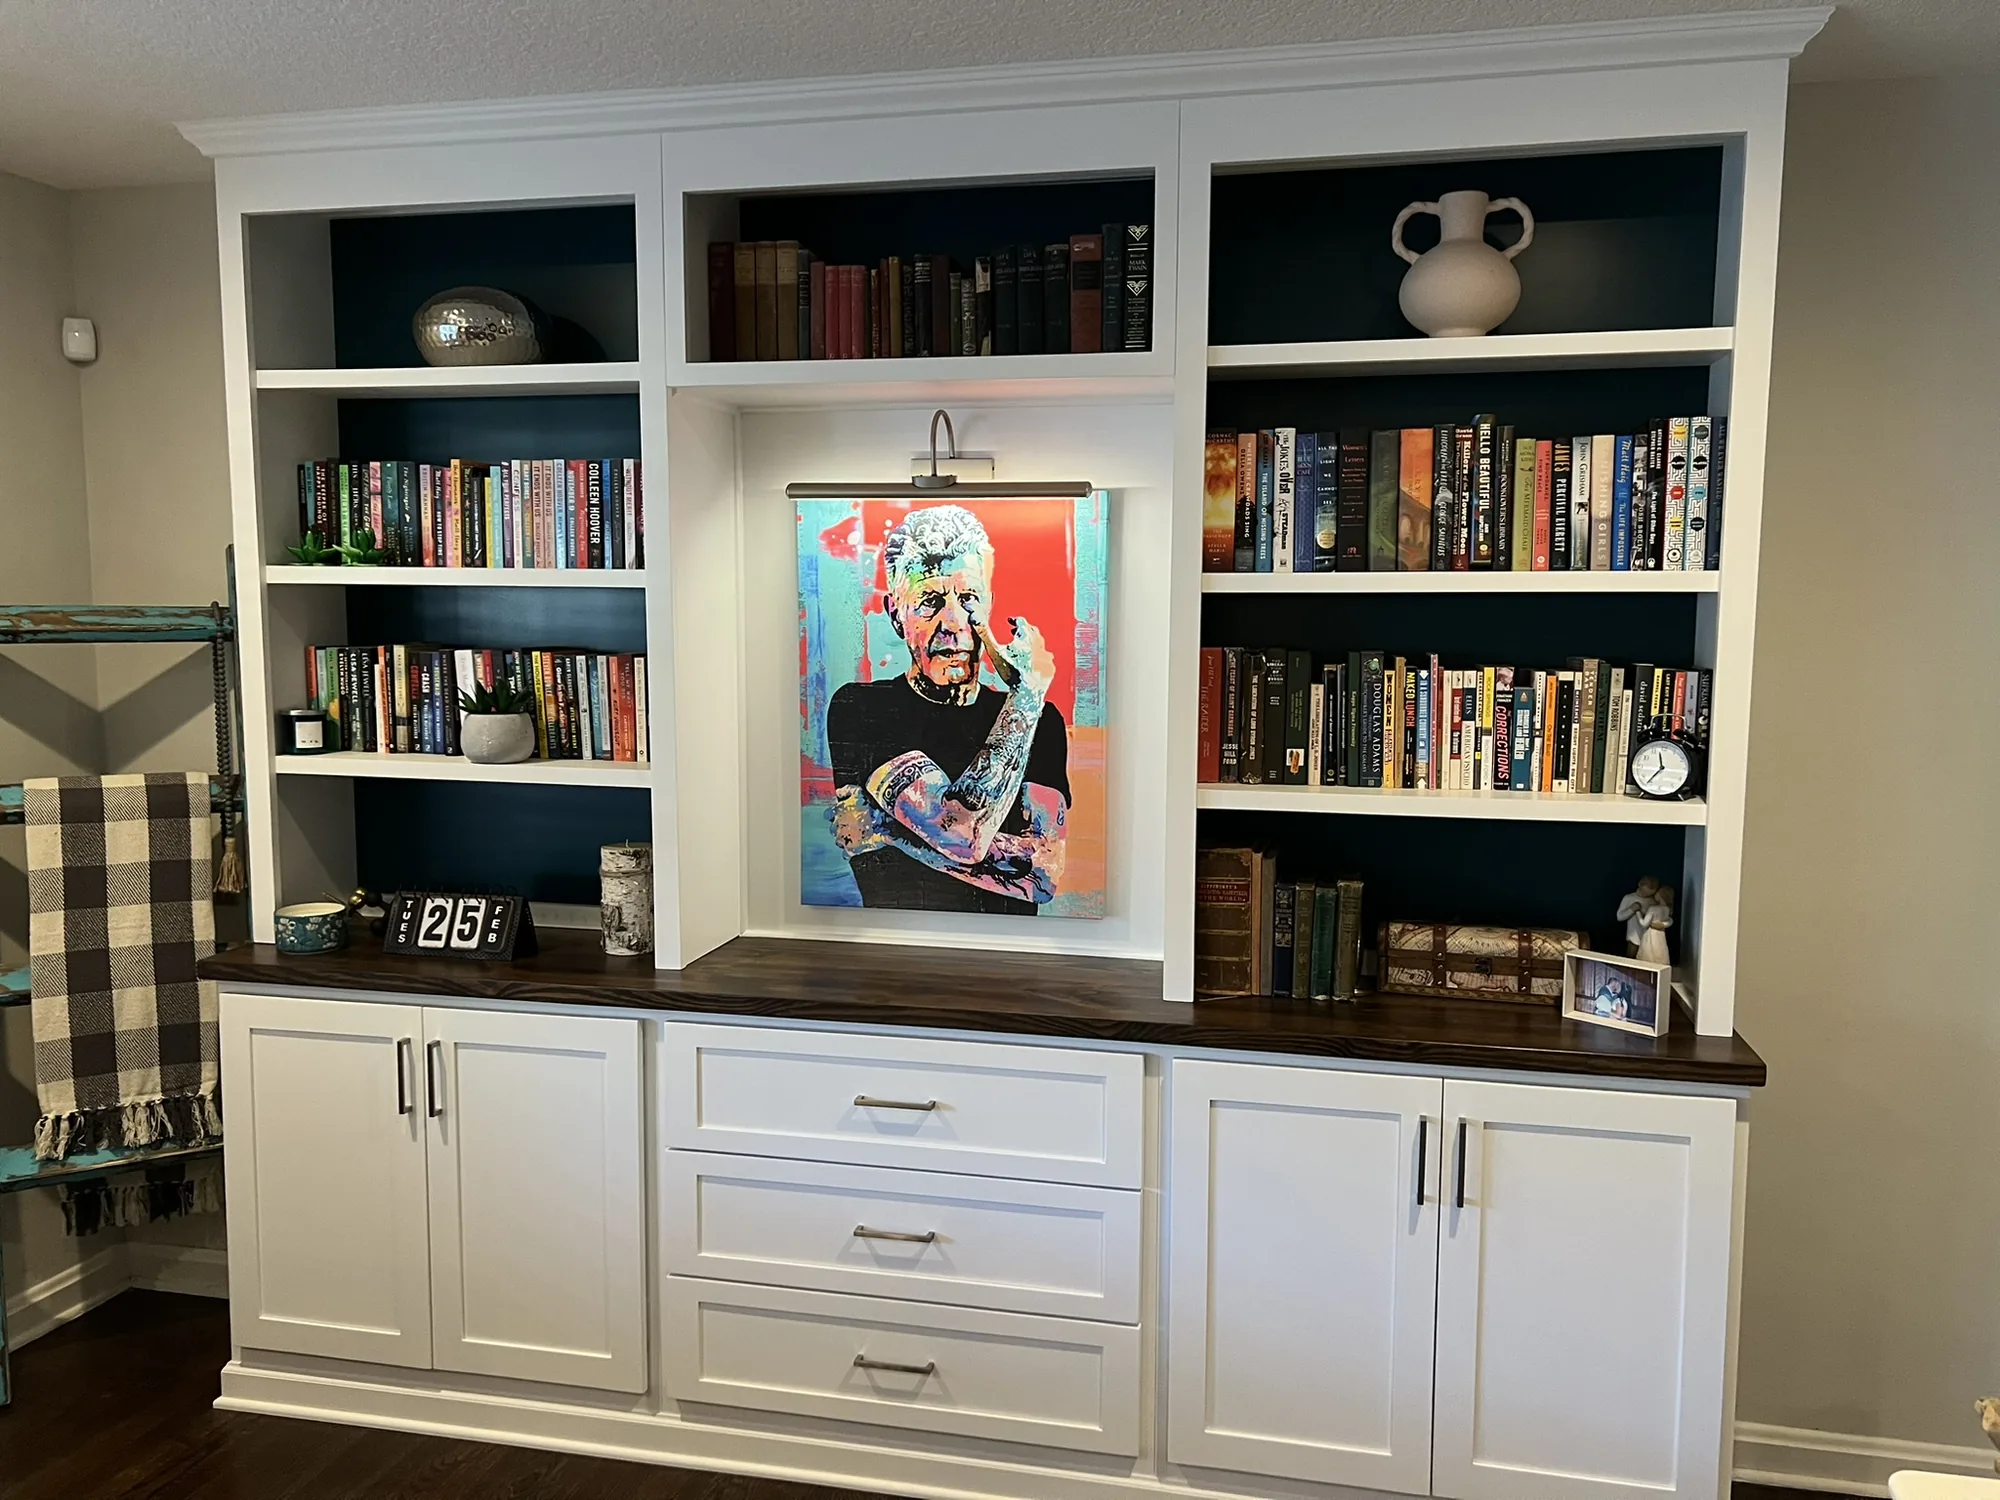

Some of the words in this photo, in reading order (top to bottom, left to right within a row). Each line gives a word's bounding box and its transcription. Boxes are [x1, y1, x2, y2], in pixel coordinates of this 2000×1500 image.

[1480, 424, 1490, 455] HELLO
[1579, 442, 1588, 461] JOHN
[589, 464, 600, 504] COLLEEN
[1479, 458, 1490, 512] BEAUTIFUL
[1579, 464, 1588, 497] GRISHAM
[1617, 464, 1630, 484] Haig
[1460, 492, 1470, 526] Flower
[589, 508, 600, 544] HOOVER
[421, 674, 430, 694] CRASH
[1405, 672, 1416, 699] NAKED
[1372, 684, 1382, 733] DOUGLAS
[1405, 700, 1416, 727] LUNCH
[1612, 696, 1620, 708] TOM
[1610, 708, 1618, 732] ROBBINS
[1637, 706, 1646, 732] sedaris
[1372, 738, 1380, 773] ADAMS
[1463, 724, 1472, 758] AMERICAN
[1496, 706, 1508, 779] CORRECTIONS
[1462, 758, 1470, 787] PSYCHO
[397, 900, 413, 943] TUES
[487, 905, 504, 943] FEB
